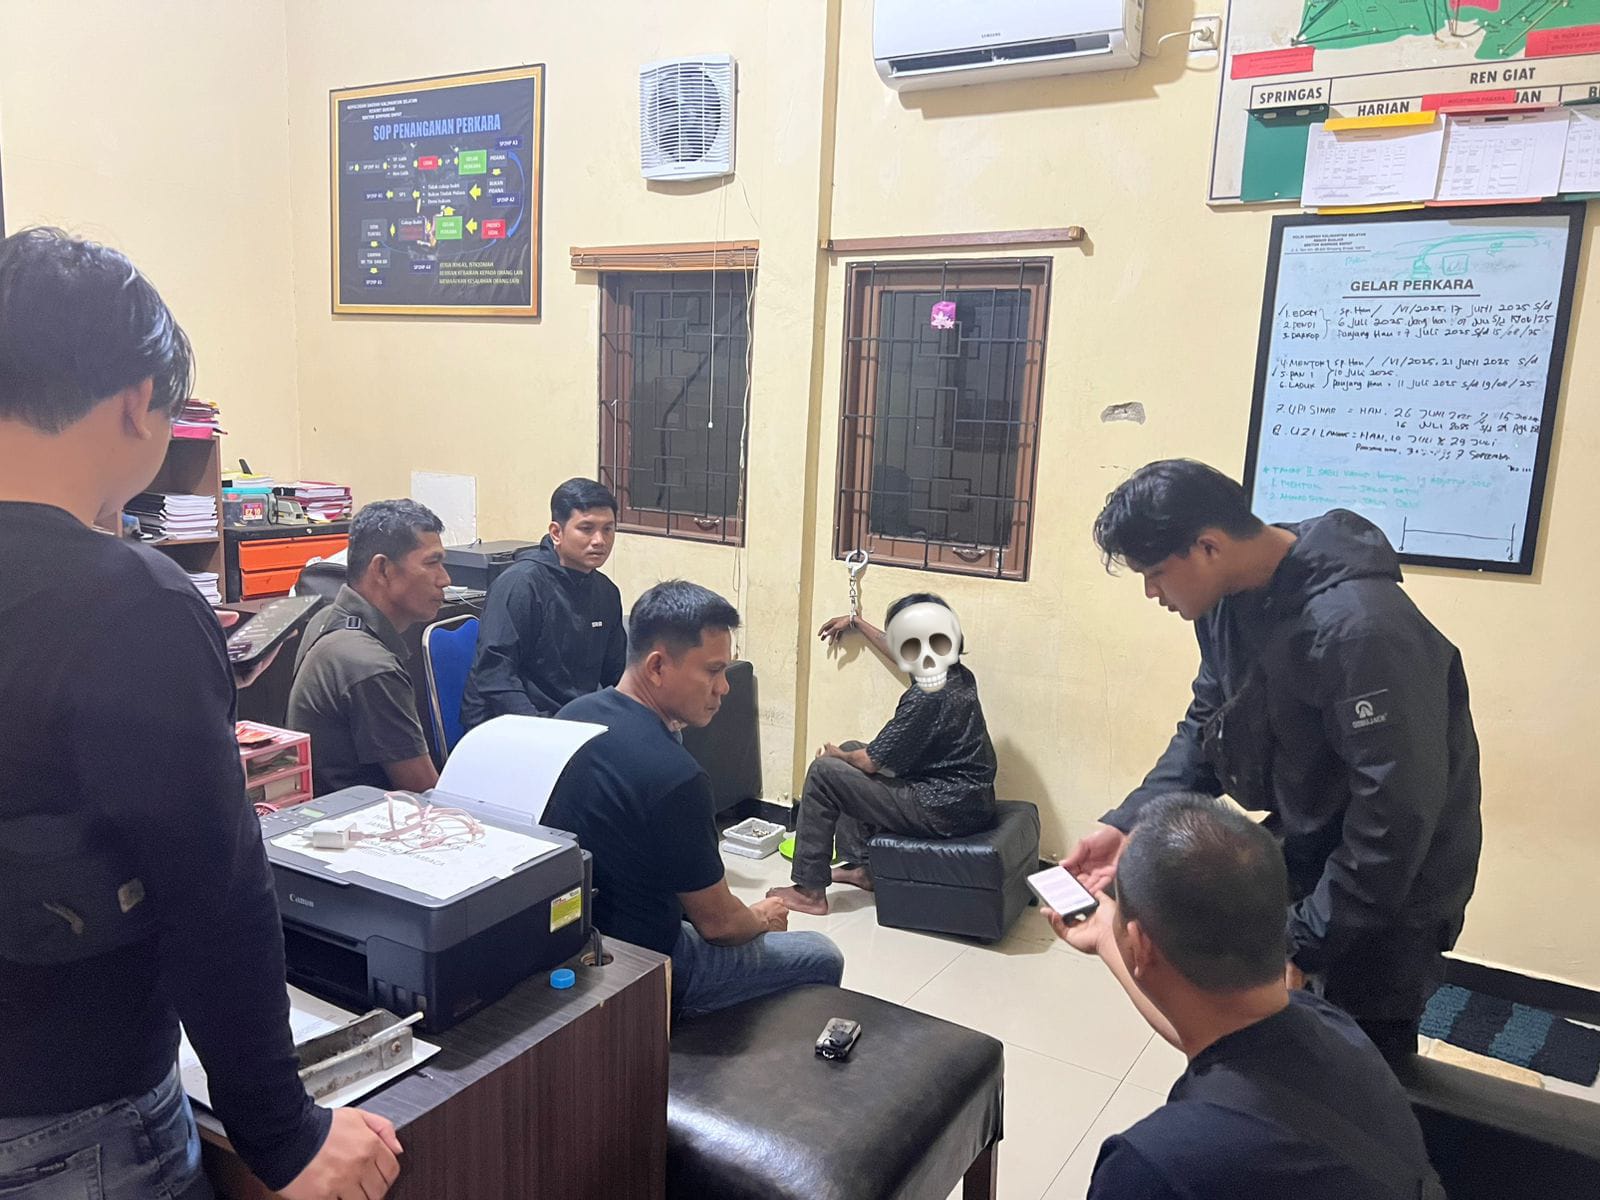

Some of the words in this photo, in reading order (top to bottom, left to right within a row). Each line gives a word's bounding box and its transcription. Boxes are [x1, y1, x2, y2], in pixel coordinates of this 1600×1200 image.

[1470, 71, 1497, 84] REN
[1503, 67, 1536, 81] GIAT
[1260, 87, 1322, 104] SPRINGAS
[1358, 101, 1410, 117] HARIAN
[373, 125, 392, 141] SOP
[393, 119, 454, 140] PENANGANAN
[456, 114, 501, 134] PERKARA
[1351, 280, 1398, 291] GELAR
[1403, 278, 1474, 290] PERKARA
[1498, 304, 1530, 312] 2025
[1374, 318, 1401, 326] 2025
[1483, 358, 1510, 366] 2025
